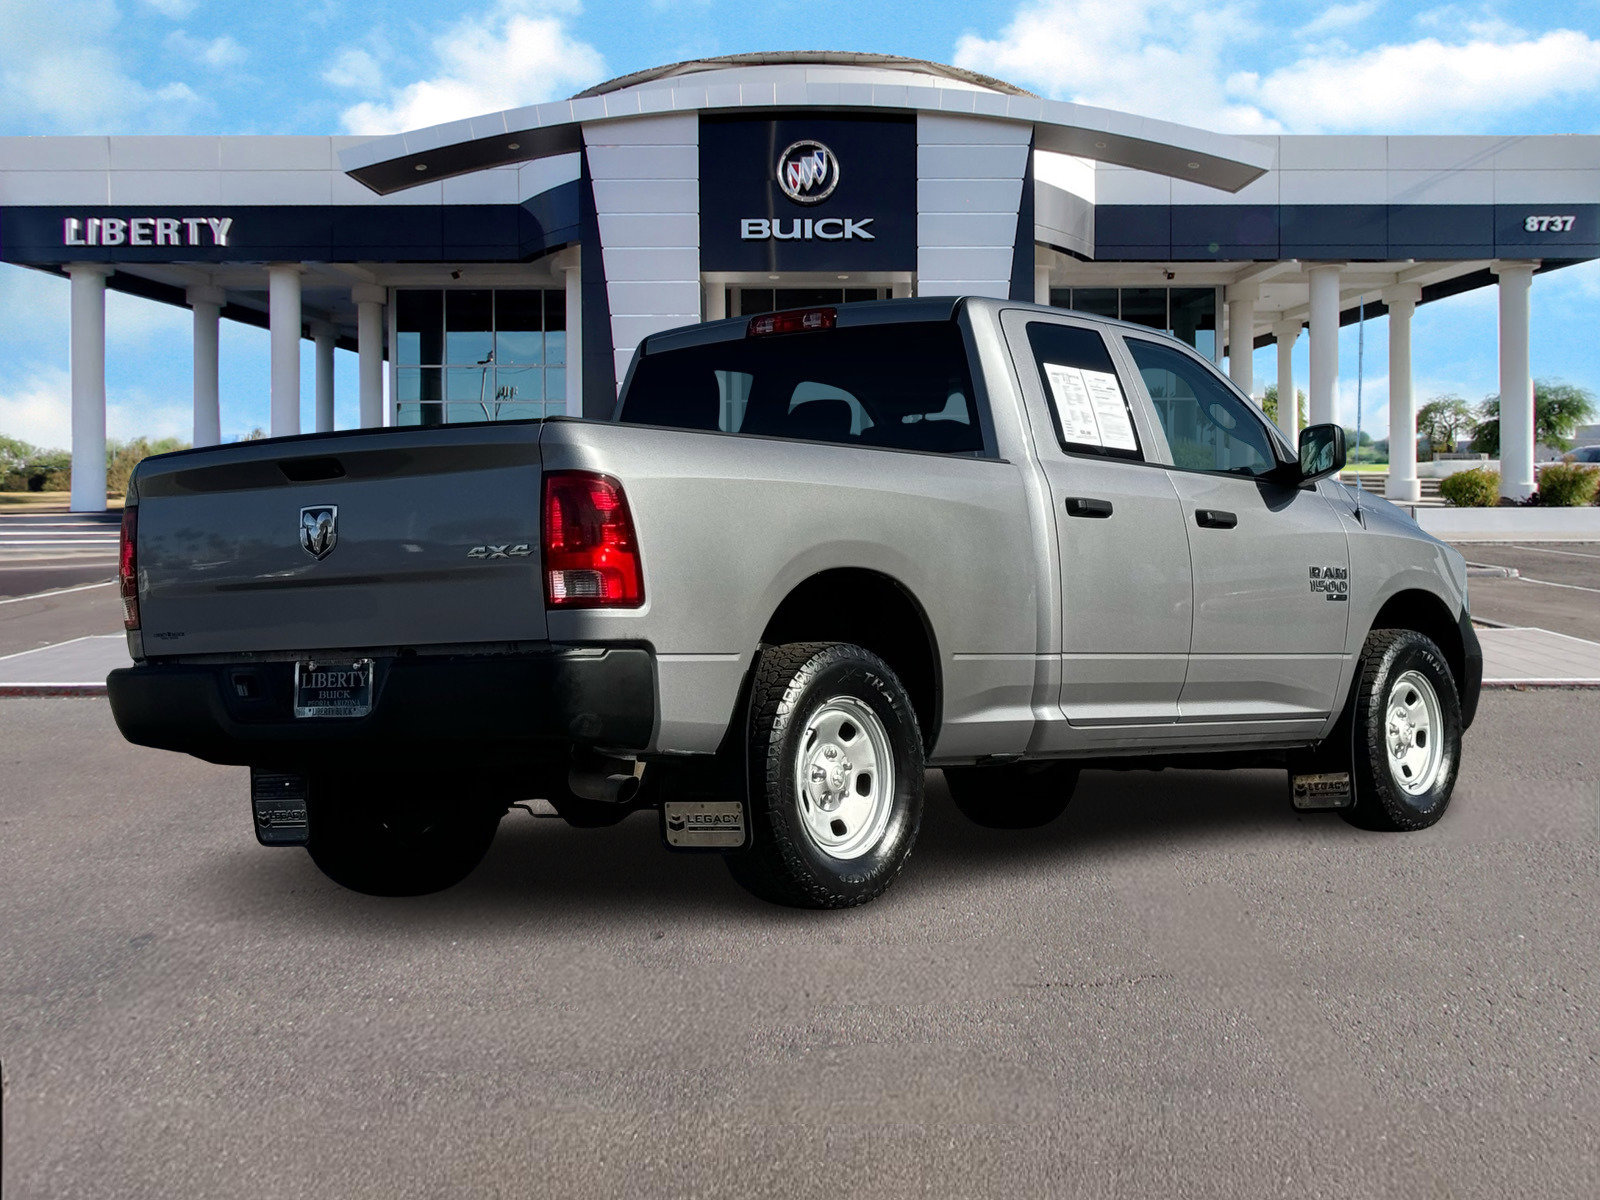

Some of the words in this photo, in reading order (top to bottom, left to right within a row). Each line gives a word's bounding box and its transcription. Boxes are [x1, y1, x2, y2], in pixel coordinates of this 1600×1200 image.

[741, 218, 876, 240] BUICK
[1524, 215, 1576, 232] 8737
[63, 217, 233, 247] LIBERTY
[1309, 566, 1348, 580] RAM
[1310, 580, 1348, 593] 1500
[301, 671, 369, 689] LIBERTY
[318, 690, 351, 699] BUICK
[1307, 781, 1349, 791] LEGACY
[270, 809, 307, 821] LEGACY
[686, 814, 740, 824] LEGACY
